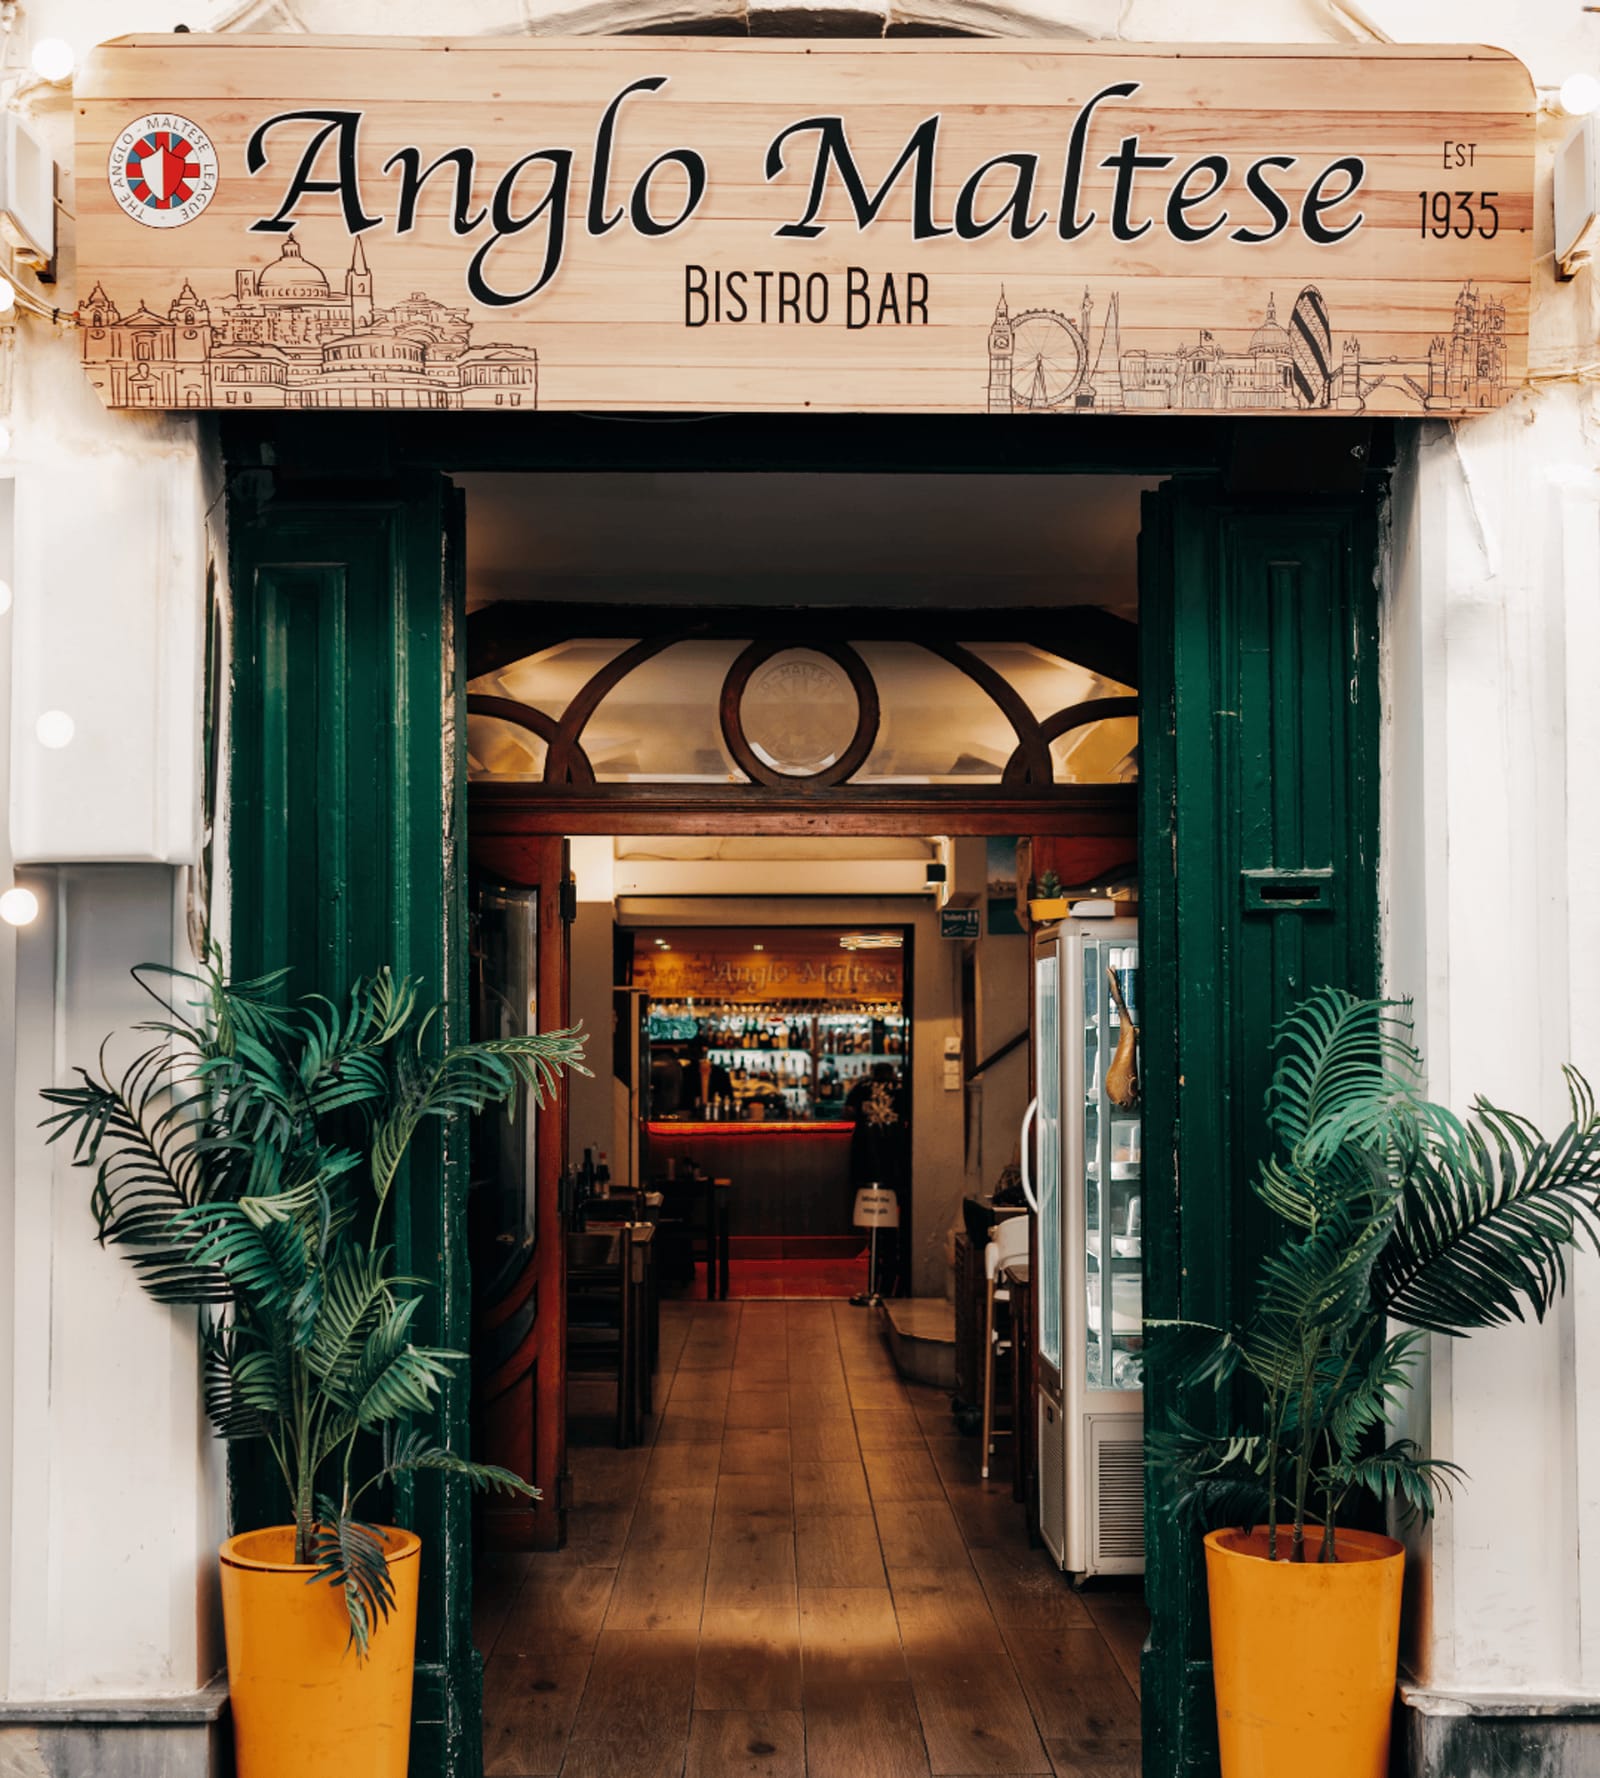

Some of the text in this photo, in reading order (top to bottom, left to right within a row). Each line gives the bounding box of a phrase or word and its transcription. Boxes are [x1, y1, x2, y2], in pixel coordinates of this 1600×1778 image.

[112, 117, 216, 221] THE ANGLO MALTESE LEAGUE
[246, 76, 1365, 306] Anglo Maltese
[1418, 190, 1500, 240] 1935
[711, 958, 897, 994] Anglo Maltese
